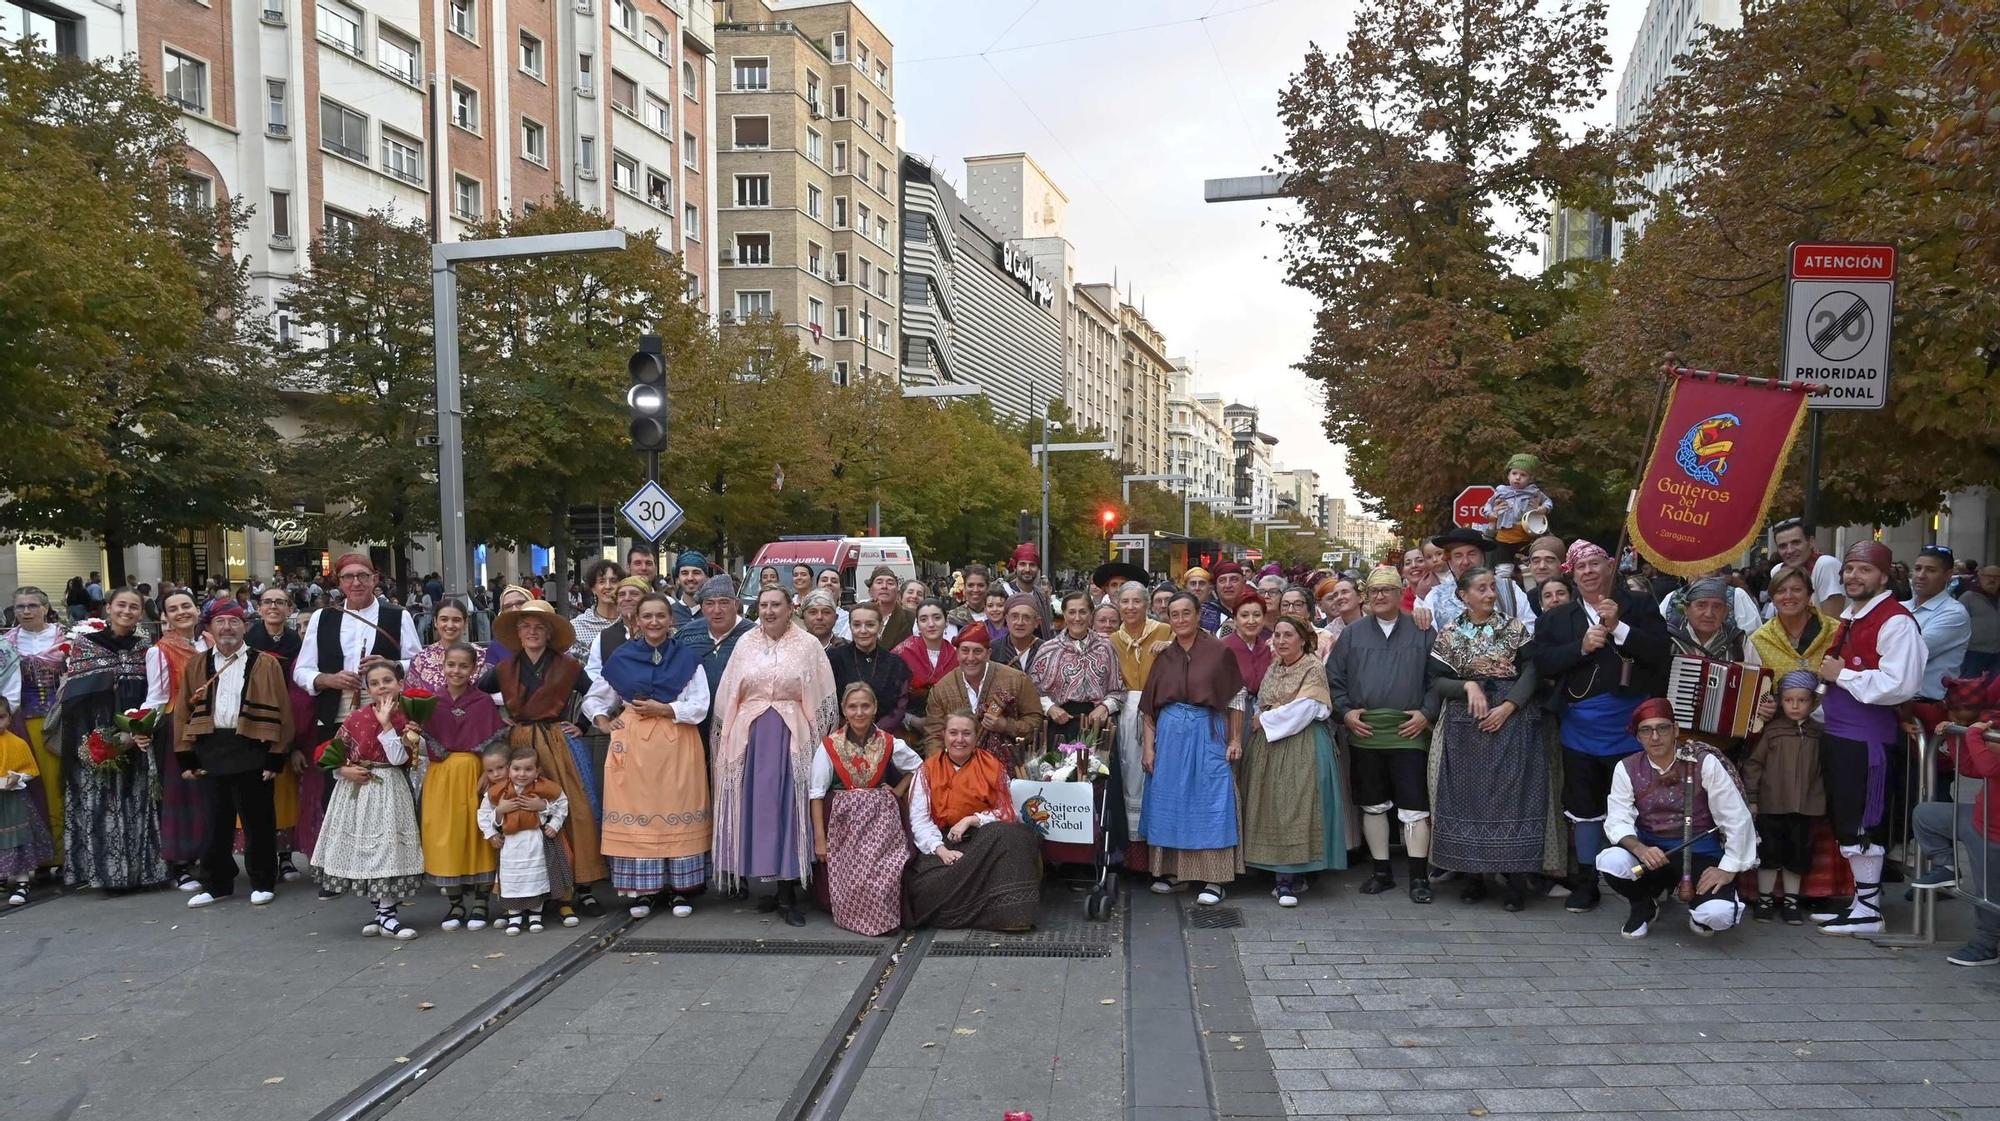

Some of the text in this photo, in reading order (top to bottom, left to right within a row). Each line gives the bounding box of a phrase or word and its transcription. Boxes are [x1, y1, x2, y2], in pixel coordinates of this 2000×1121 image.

[1804, 255, 1883, 268] ATENCIÓN
[1814, 310, 1866, 343] 20
[1795, 367, 1877, 381] PRIORIDAD
[1658, 478, 1730, 502] Gaiteros
[1679, 496, 1698, 508] del
[638, 500, 666, 521] 30
[1660, 504, 1710, 526] Rabal
[1660, 529, 1696, 543] Zaragoza
[1043, 802, 1091, 814] Gaiteros
[1051, 811, 1066, 820] del
[1052, 821, 1083, 830] Rabal
